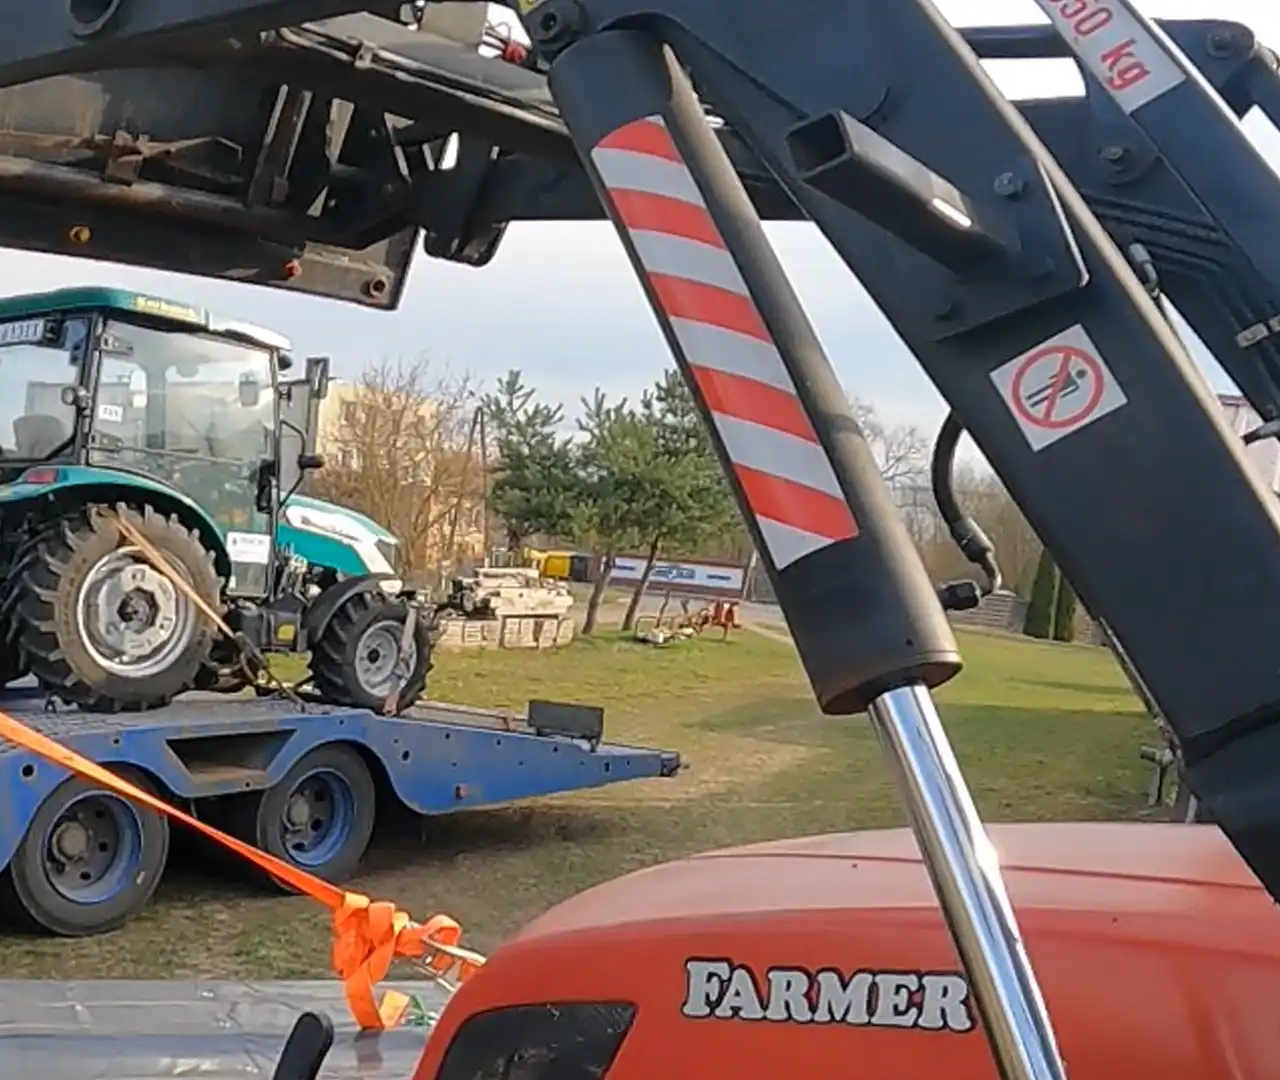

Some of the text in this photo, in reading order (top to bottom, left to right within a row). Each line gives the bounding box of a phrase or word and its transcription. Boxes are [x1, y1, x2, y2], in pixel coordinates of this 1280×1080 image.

[1048, 0, 1152, 92] 50 kg
[681, 956, 974, 1032] FARMER
